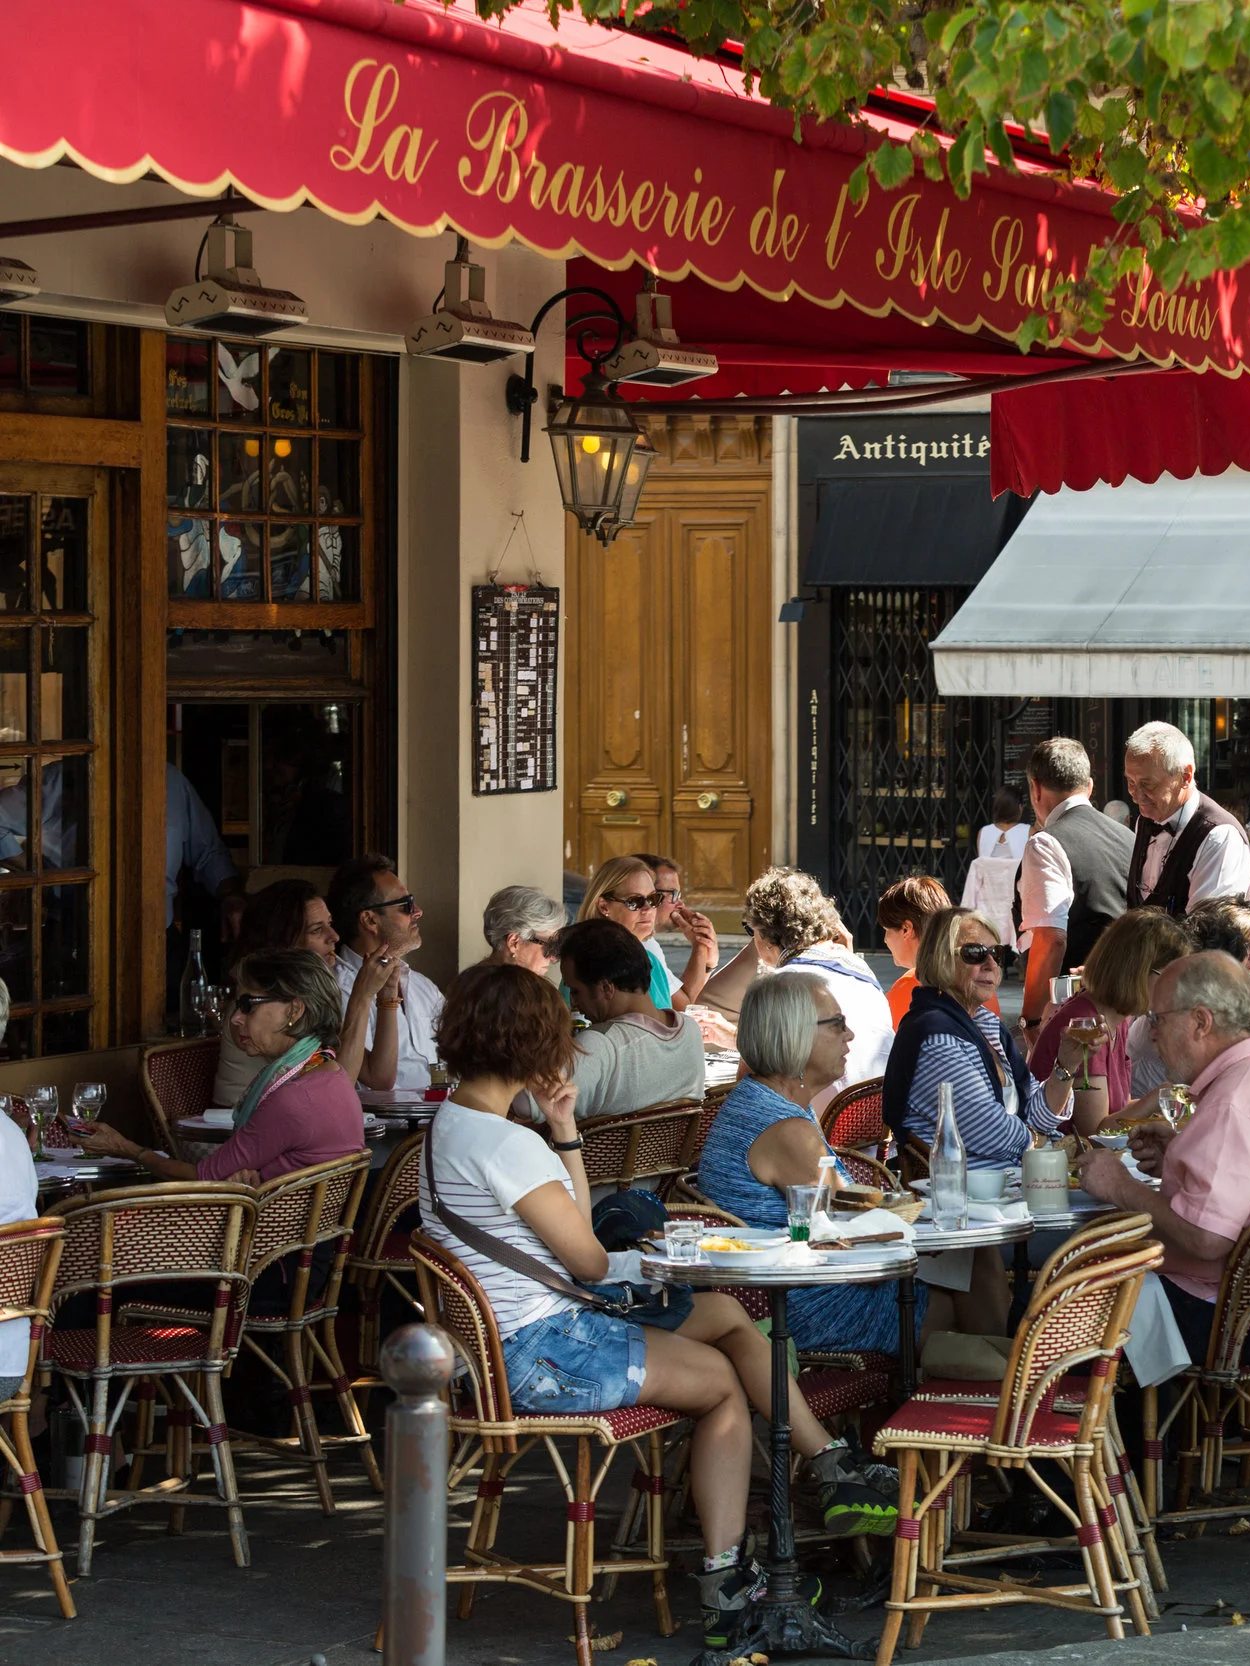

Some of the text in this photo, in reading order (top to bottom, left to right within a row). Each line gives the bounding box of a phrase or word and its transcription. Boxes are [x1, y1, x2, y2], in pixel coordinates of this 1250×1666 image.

[329, 58, 439, 184] La
[458, 89, 736, 247] Brasserie
[749, 168, 810, 263] de
